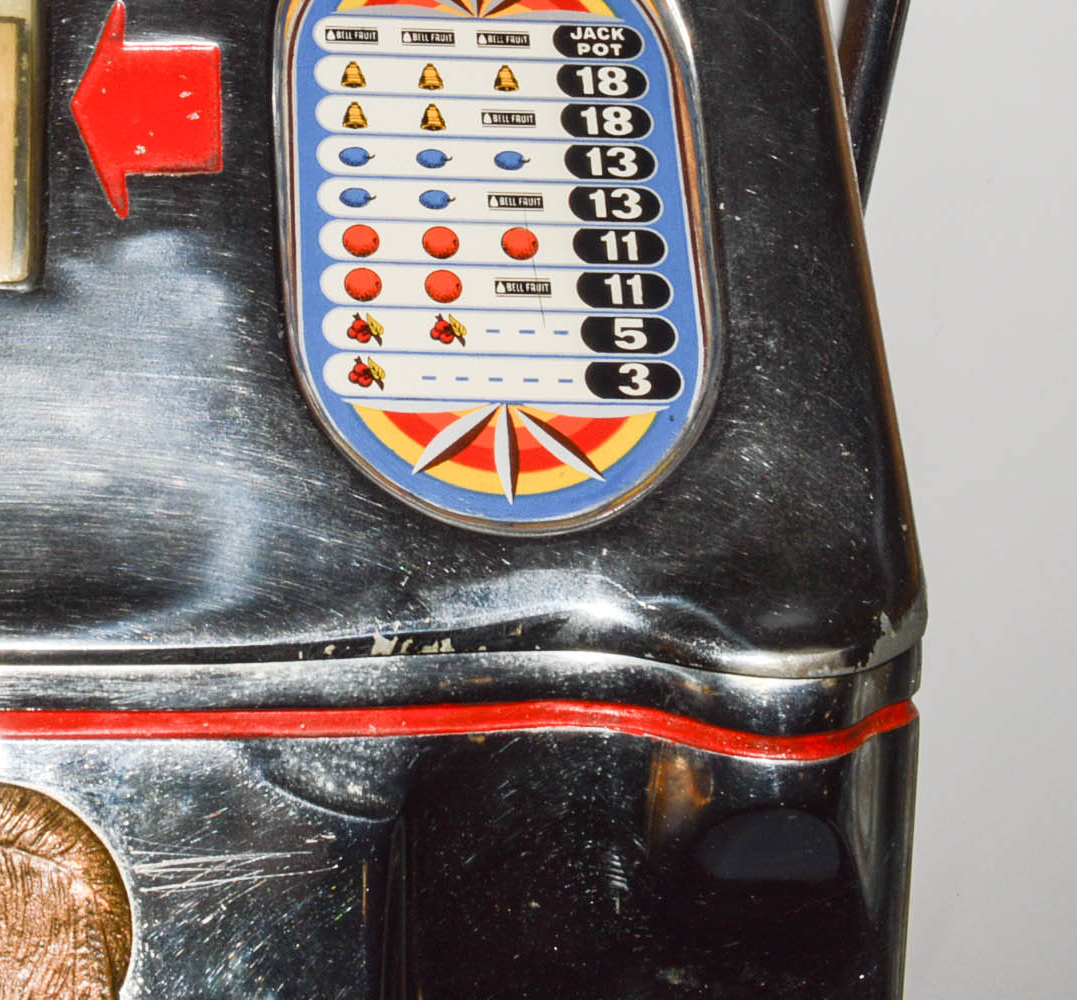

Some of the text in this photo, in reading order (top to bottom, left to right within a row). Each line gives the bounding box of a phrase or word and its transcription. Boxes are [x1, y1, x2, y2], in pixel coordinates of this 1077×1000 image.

[336, 30, 377, 41] BELL FRUIT
[412, 32, 453, 43] BELL FRUIT
[487, 34, 529, 45] BELL FRUIT
[570, 27, 624, 40] JACK
[577, 43, 622, 56] POT
[576, 67, 628, 95] 18
[493, 114, 535, 125] BELL FRUIT
[581, 106, 633, 135] 18
[586, 148, 638, 177] 13
[499, 196, 542, 208] BELL FRUIT
[590, 188, 642, 218] 13
[600, 231, 638, 260] 11
[506, 282, 550, 293] BELL FRUIT
[605, 274, 643, 304] 11
[614, 319, 647, 349] 5
[618, 364, 651, 395] 3
